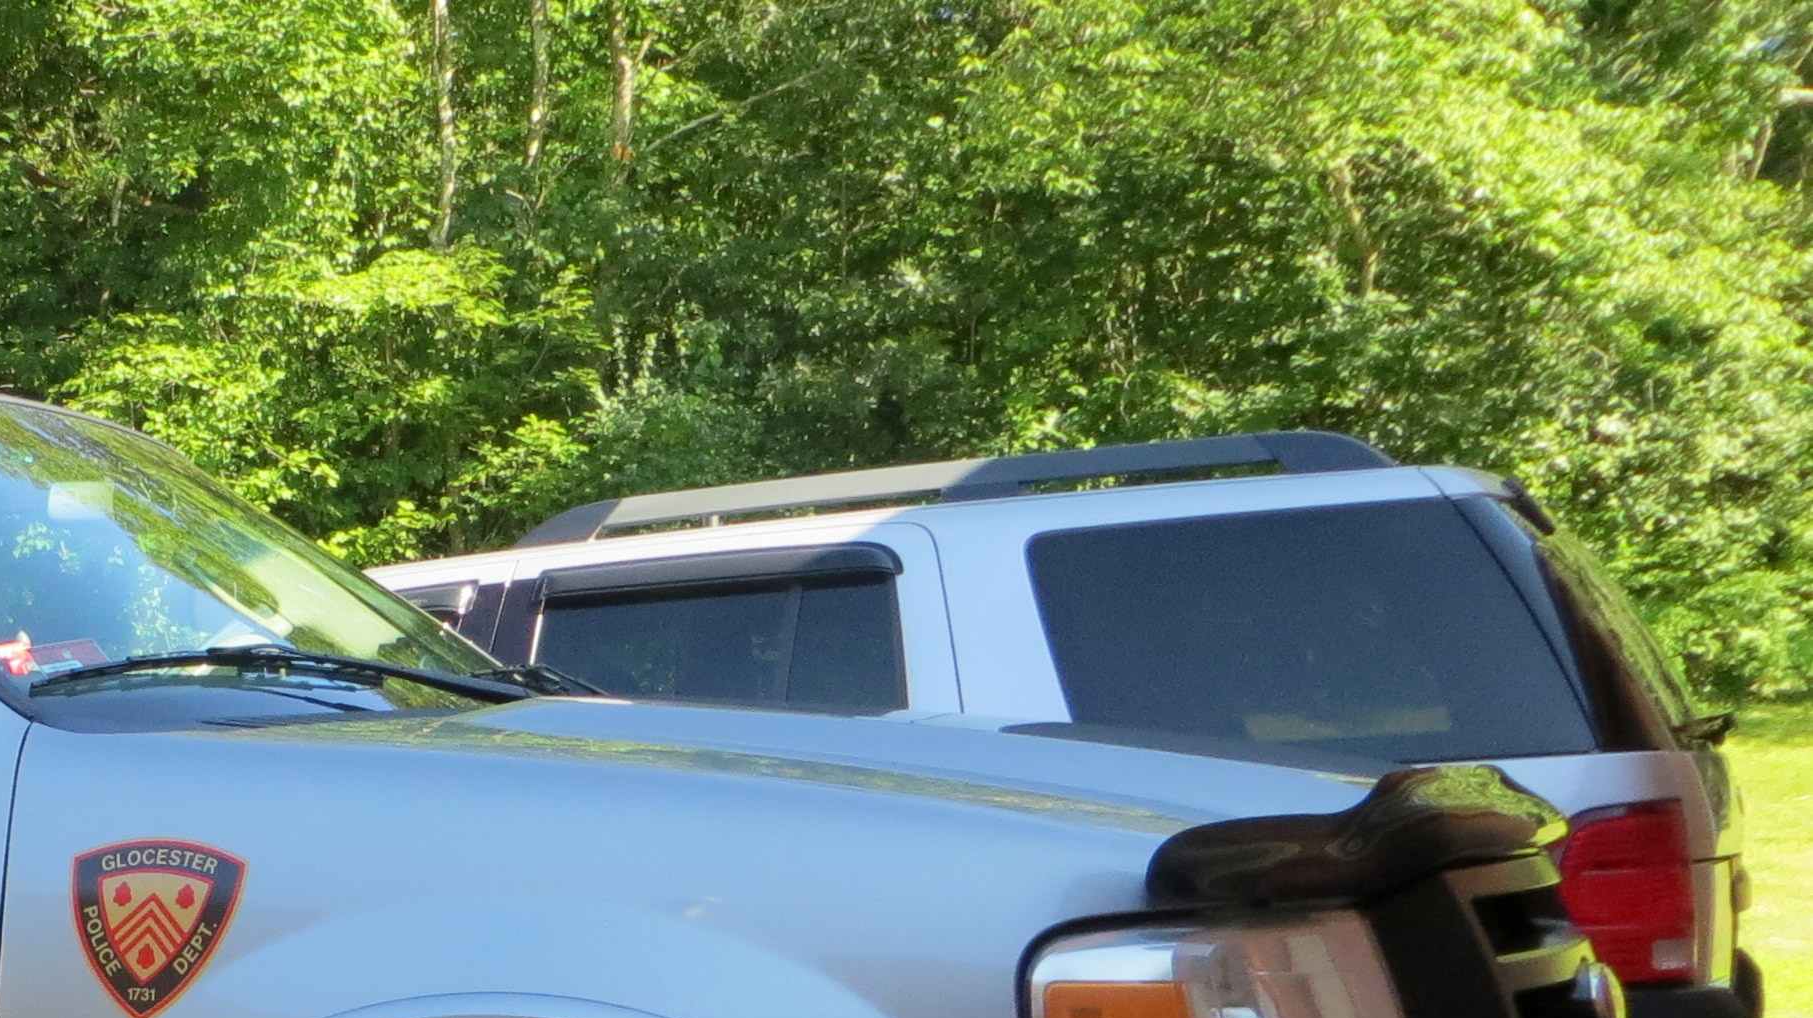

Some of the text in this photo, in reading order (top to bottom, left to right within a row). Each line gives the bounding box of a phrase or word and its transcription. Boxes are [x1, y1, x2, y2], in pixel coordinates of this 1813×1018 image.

[102, 849, 218, 874] GLOCESTER
[83, 905, 122, 977] POLICE
[173, 923, 217, 975] DEPT.
[127, 988, 156, 1001] 1731
